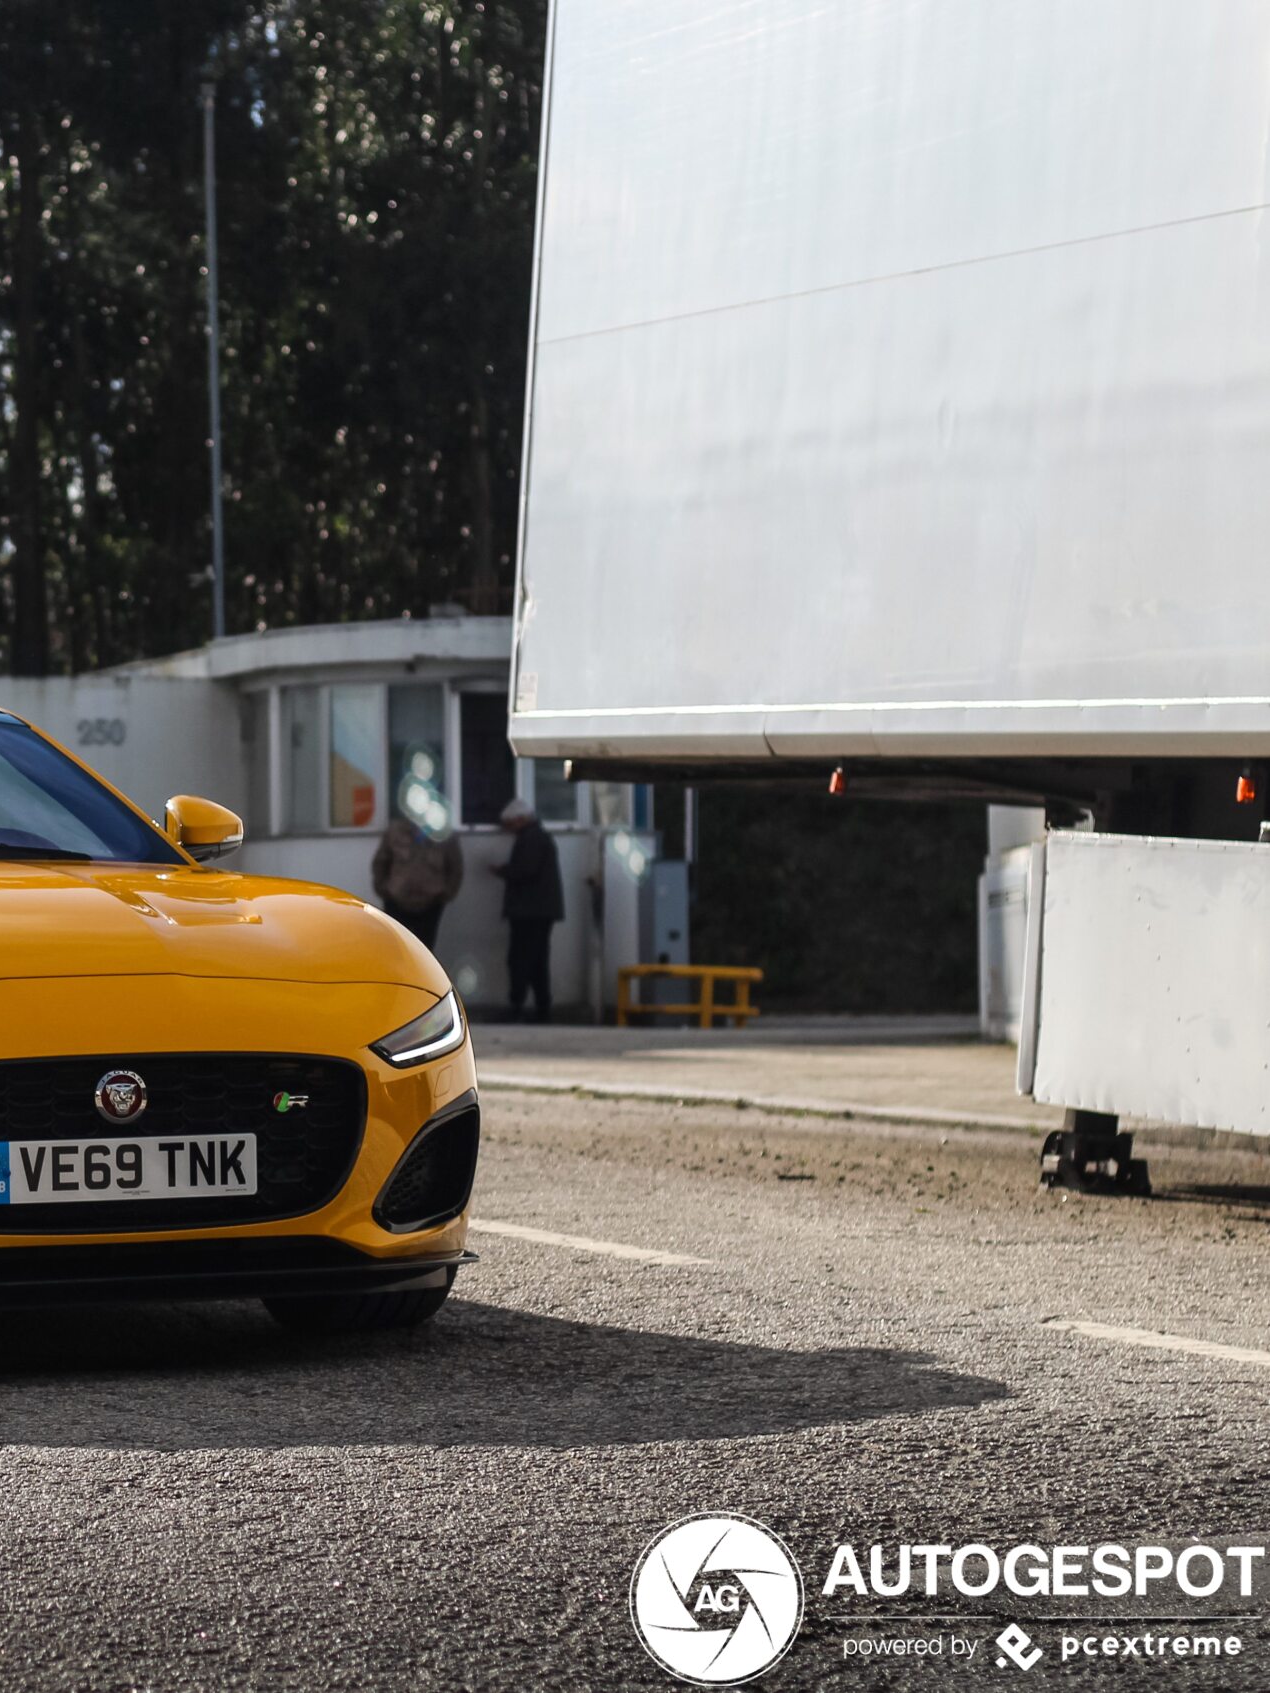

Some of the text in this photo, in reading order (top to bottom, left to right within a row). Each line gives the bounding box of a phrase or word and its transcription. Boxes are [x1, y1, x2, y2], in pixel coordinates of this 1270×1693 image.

[76, 718, 127, 747] 250
[100, 1069, 144, 1087] JAGUAR
[19, 1139, 247, 1193] VE69 TNK
